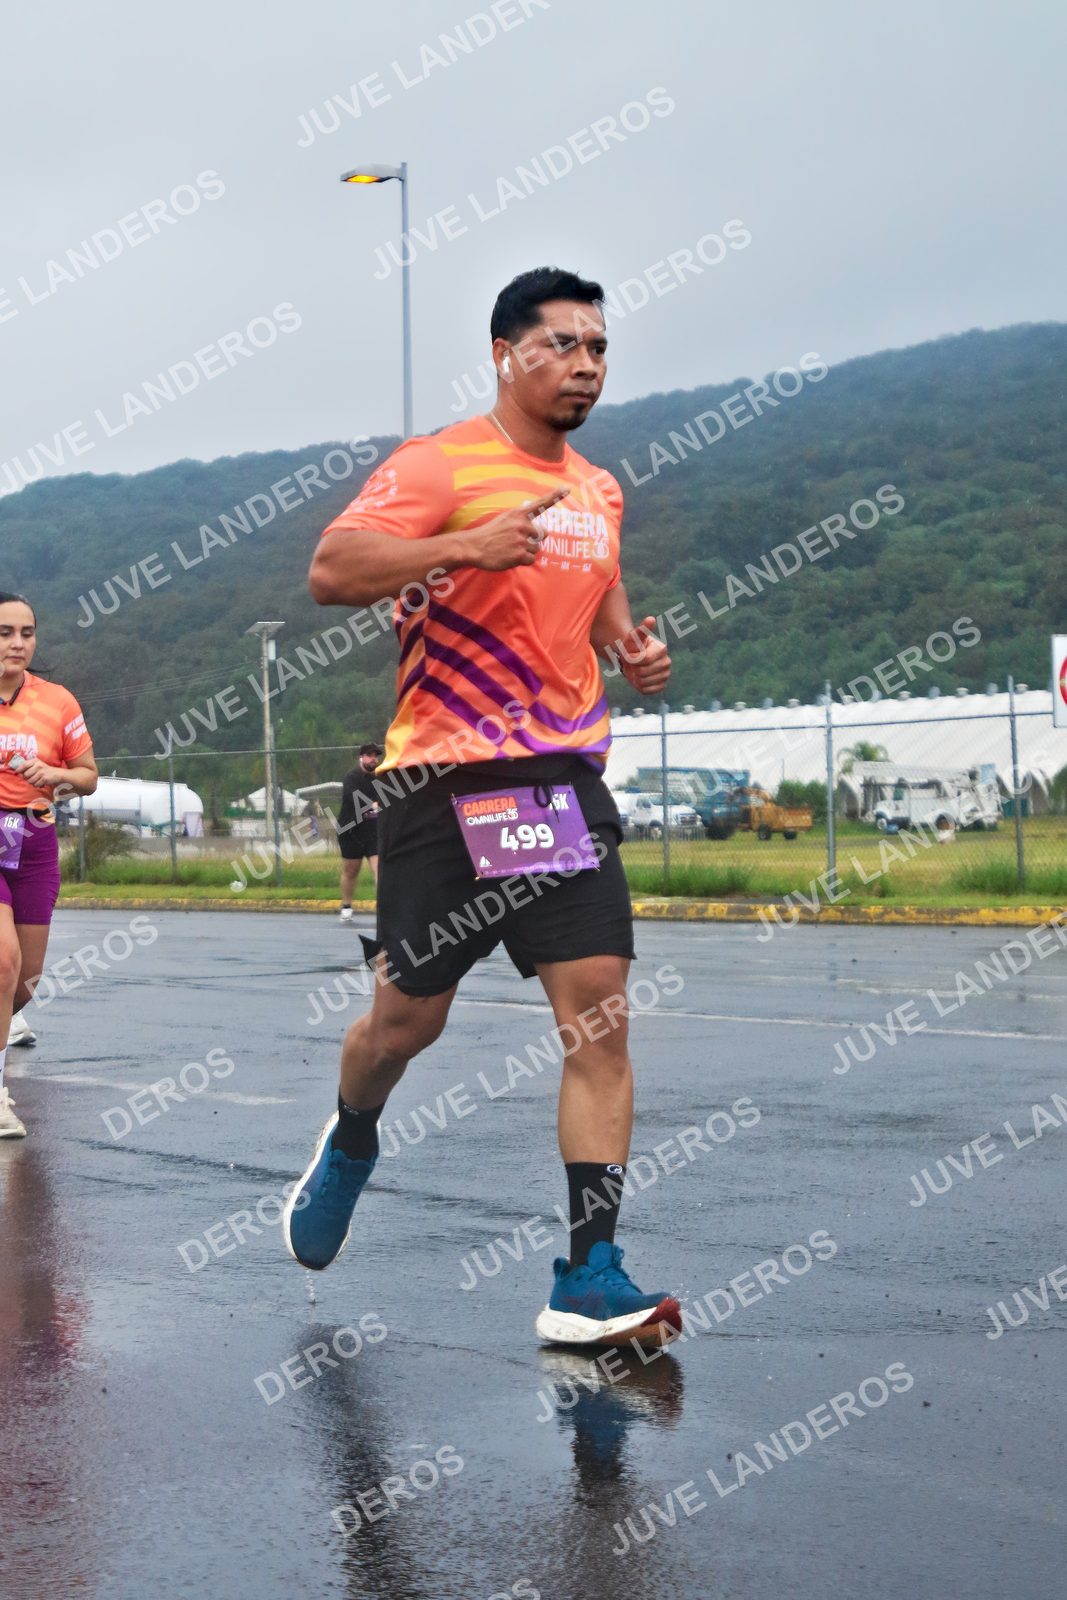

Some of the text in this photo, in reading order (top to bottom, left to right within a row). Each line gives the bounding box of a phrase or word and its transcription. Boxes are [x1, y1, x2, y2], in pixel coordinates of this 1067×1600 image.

[523, 500, 608, 537] ARRERA
[462, 796, 517, 816] CARRERA
[500, 823, 555, 850] 499
